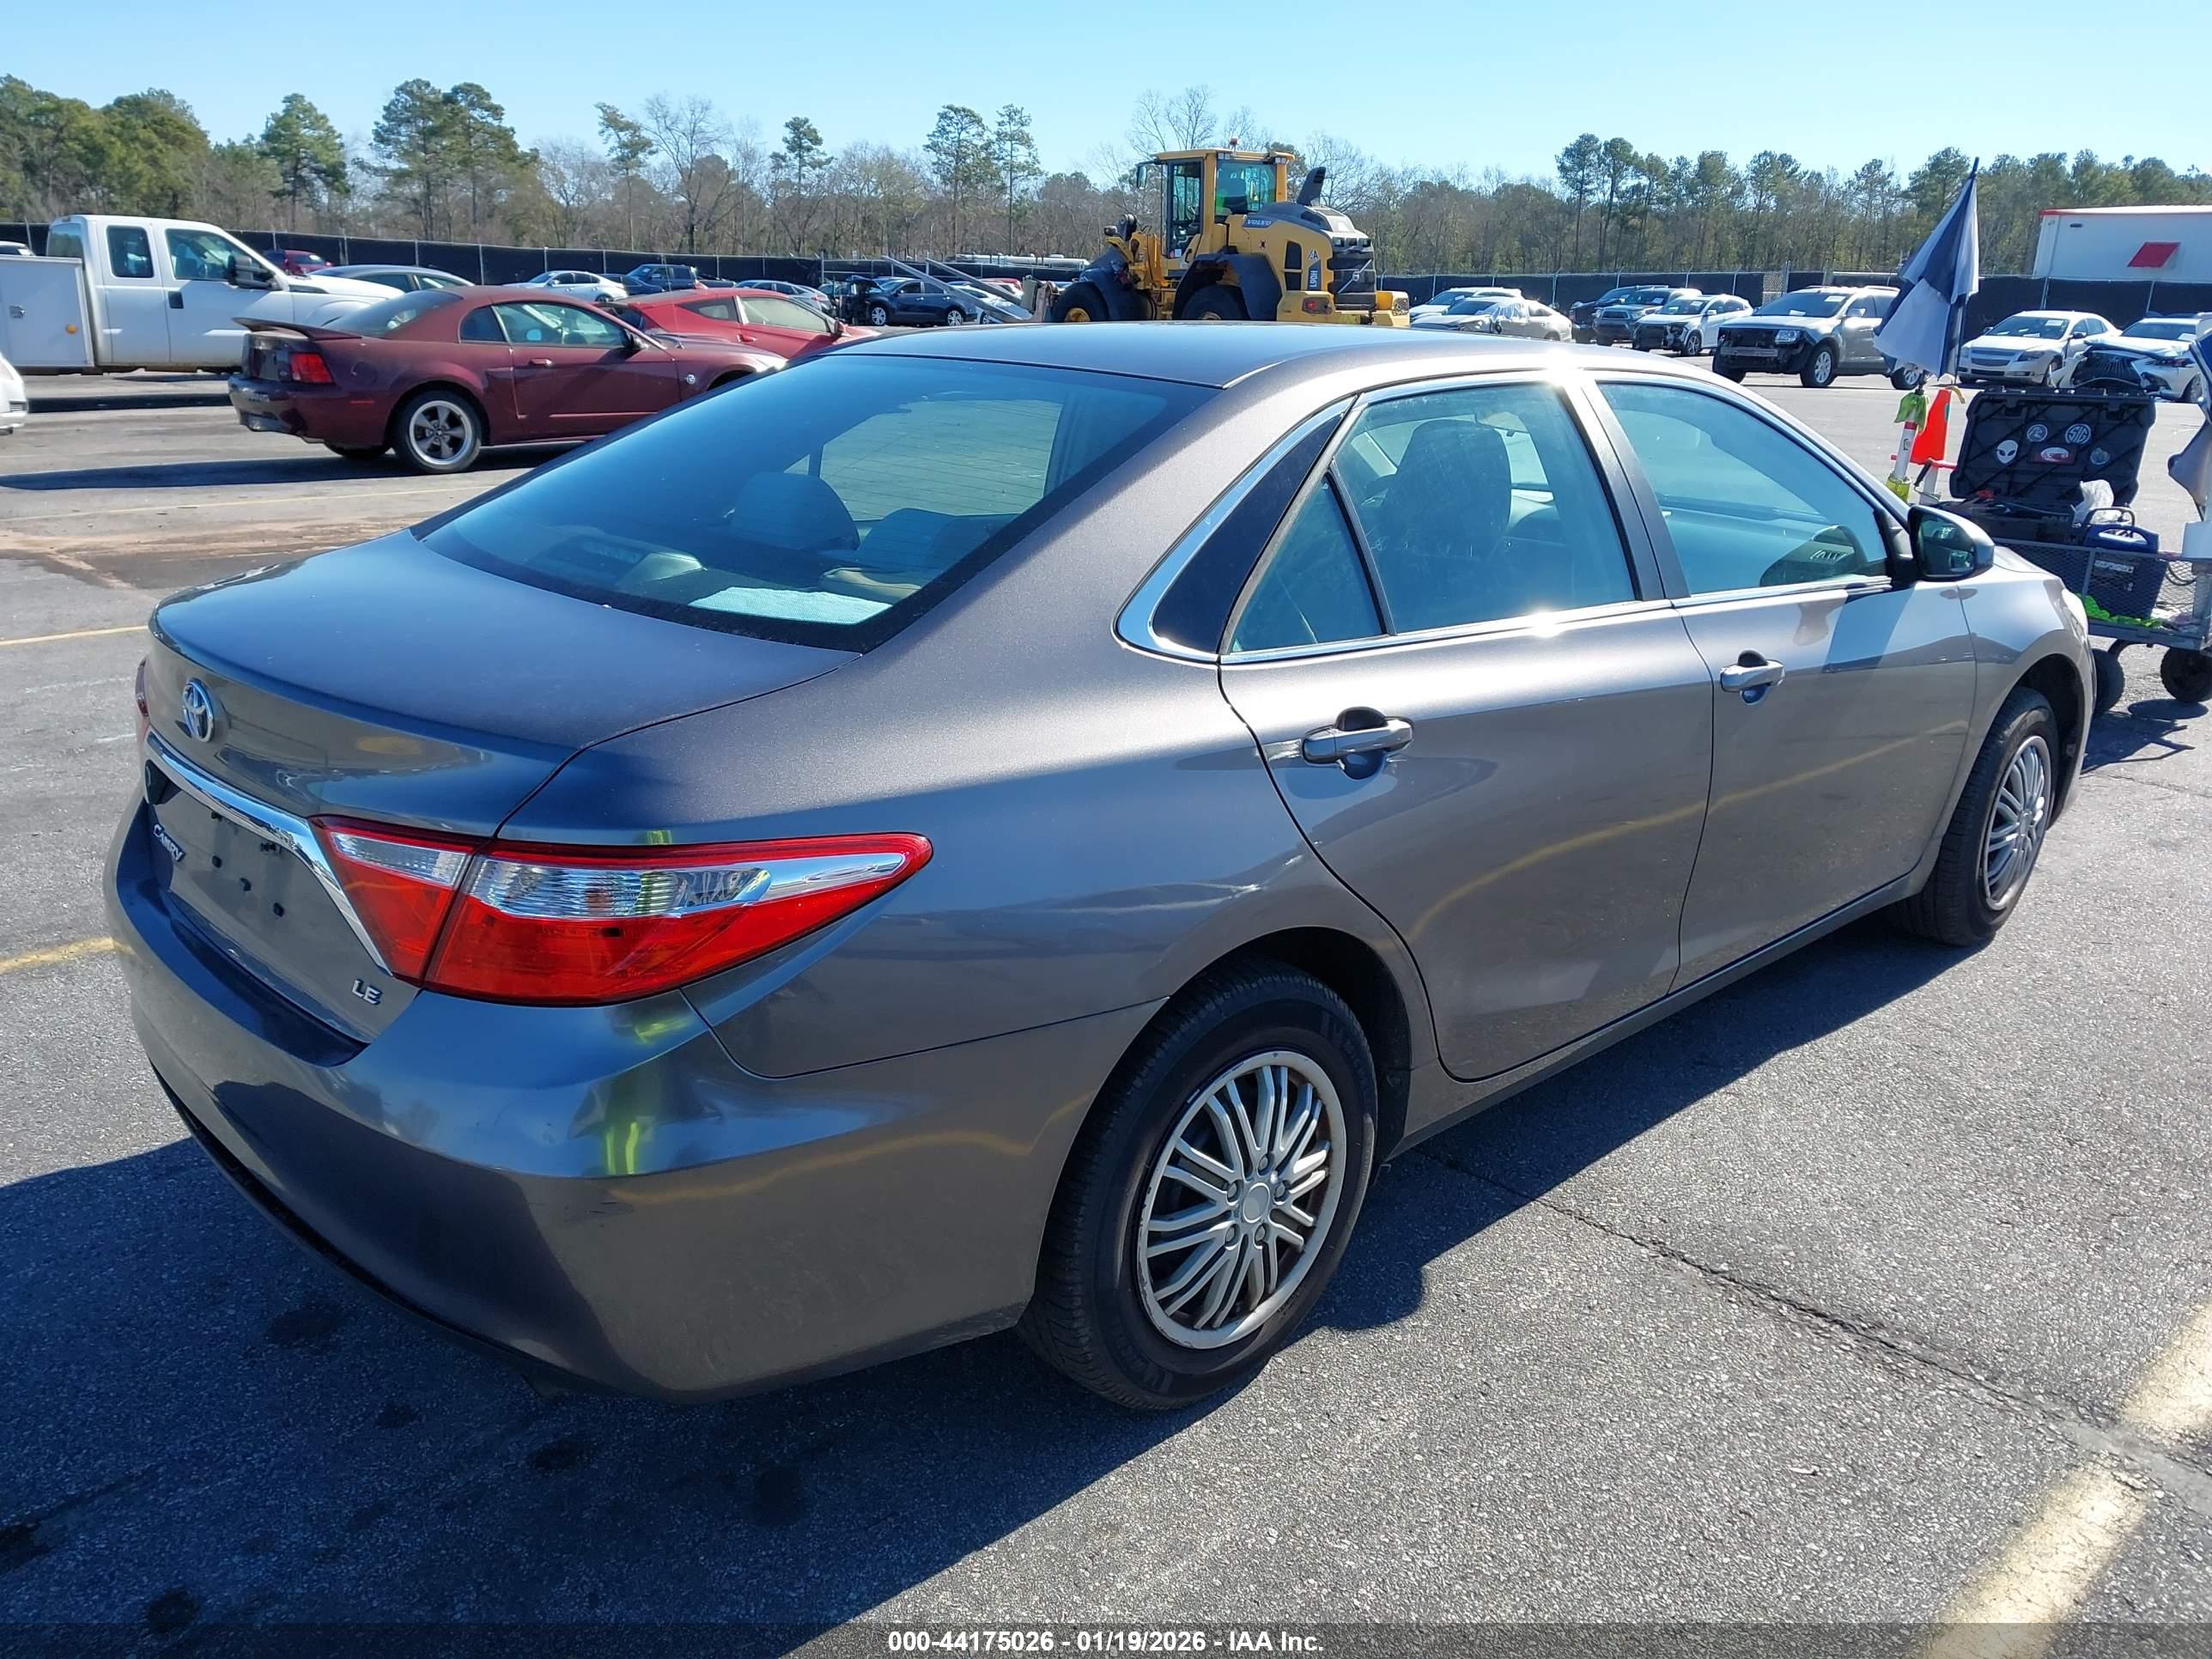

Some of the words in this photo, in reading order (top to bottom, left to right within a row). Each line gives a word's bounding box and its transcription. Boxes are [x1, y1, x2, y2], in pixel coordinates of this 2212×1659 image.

[1309, 270, 1319, 288] L90H
[2067, 425, 2089, 441] SIG
[153, 823, 184, 860] CAMRY
[352, 979, 381, 1004] LE
